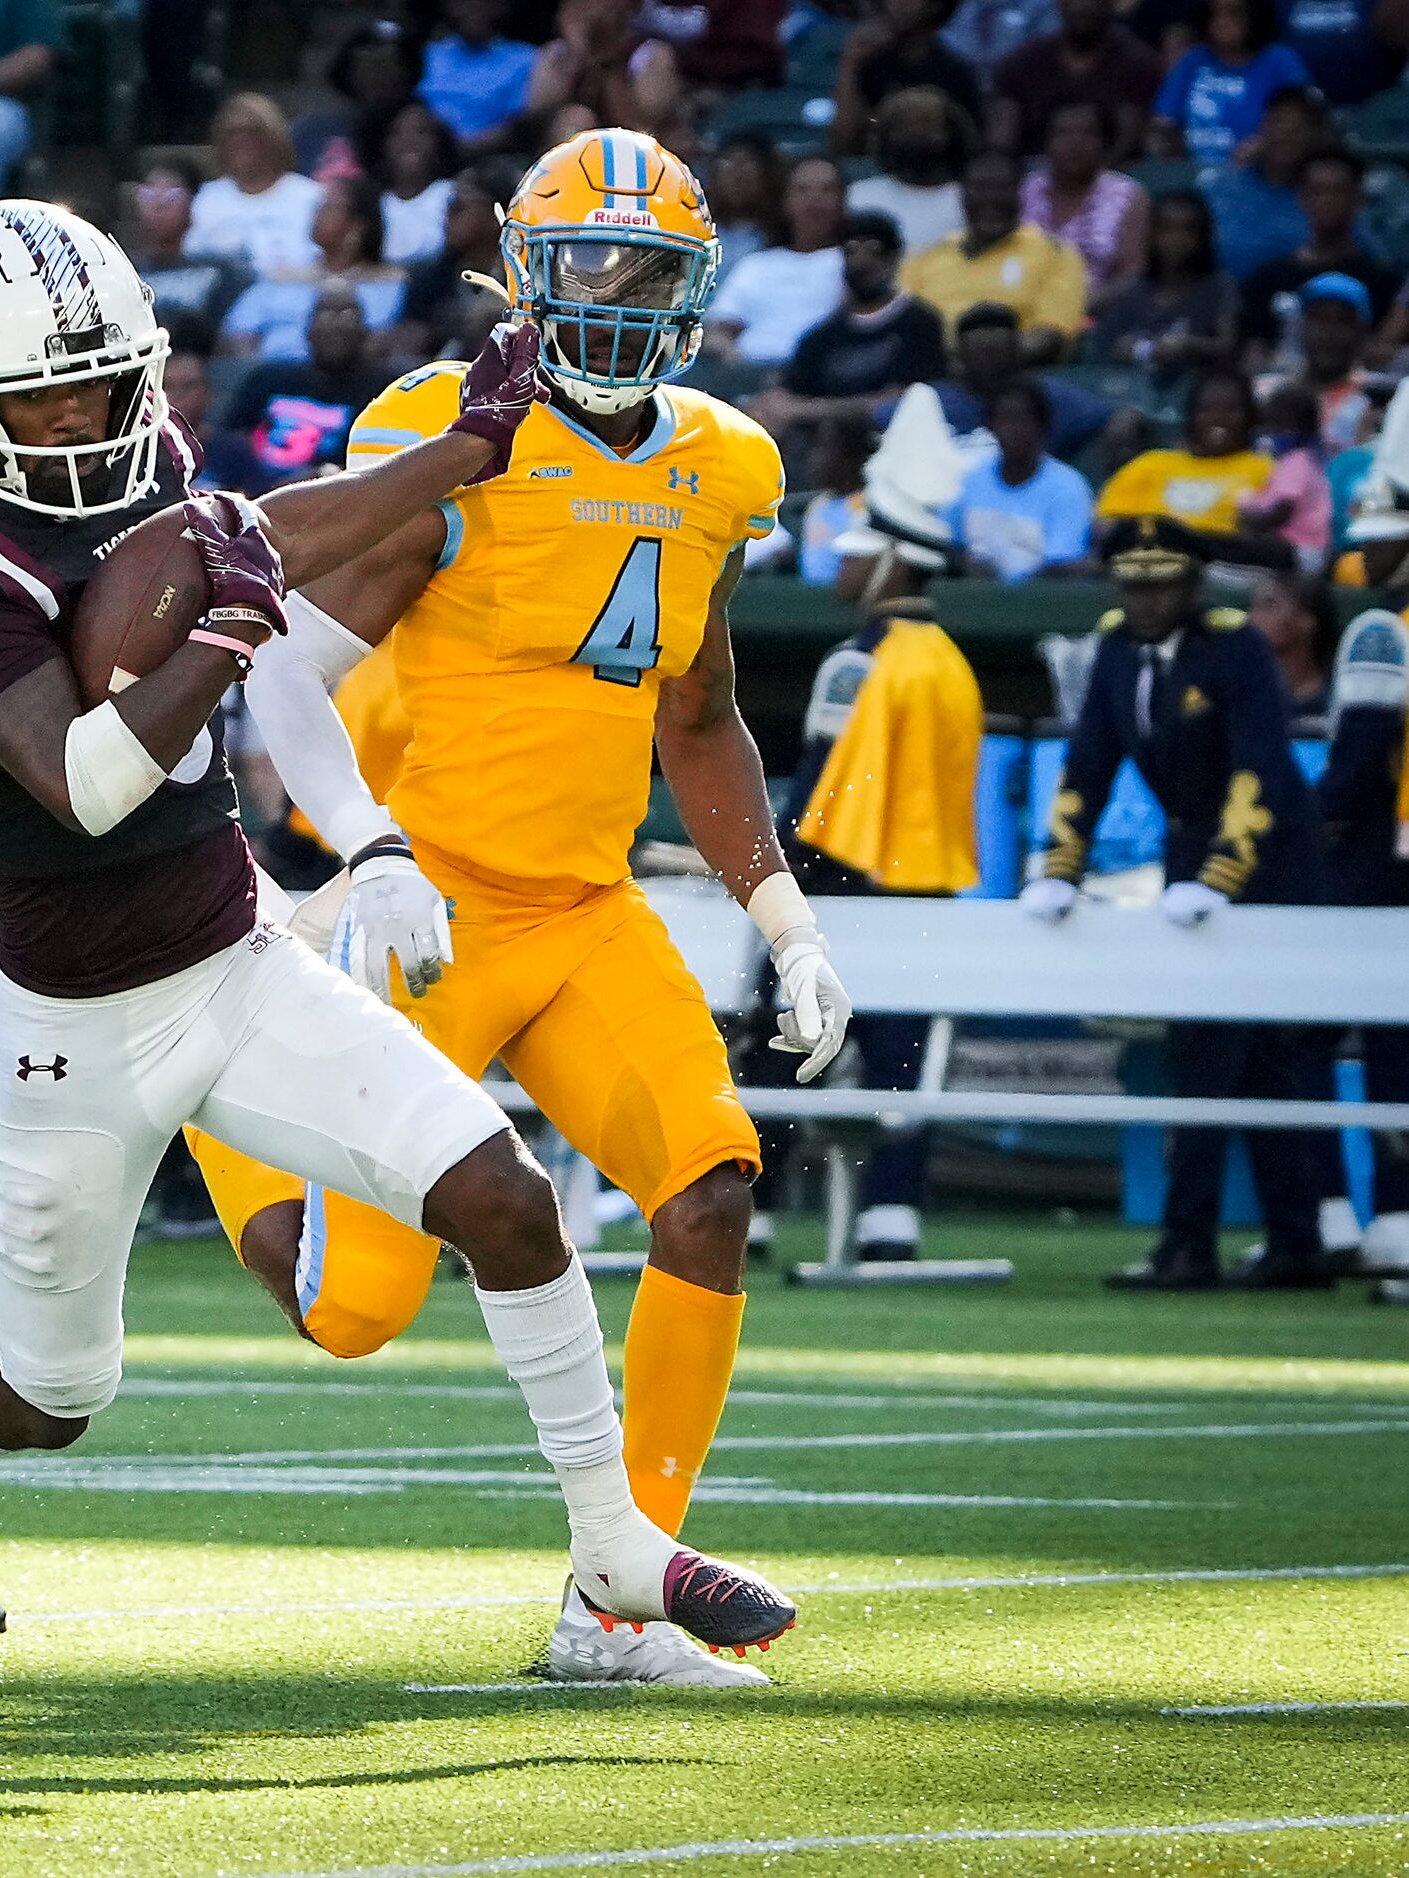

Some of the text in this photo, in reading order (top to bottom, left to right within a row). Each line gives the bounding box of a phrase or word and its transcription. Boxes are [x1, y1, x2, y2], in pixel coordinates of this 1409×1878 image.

[594, 211, 651, 226] Riddell
[570, 499, 684, 530] SOUTHERN
[569, 535, 663, 688] 4
